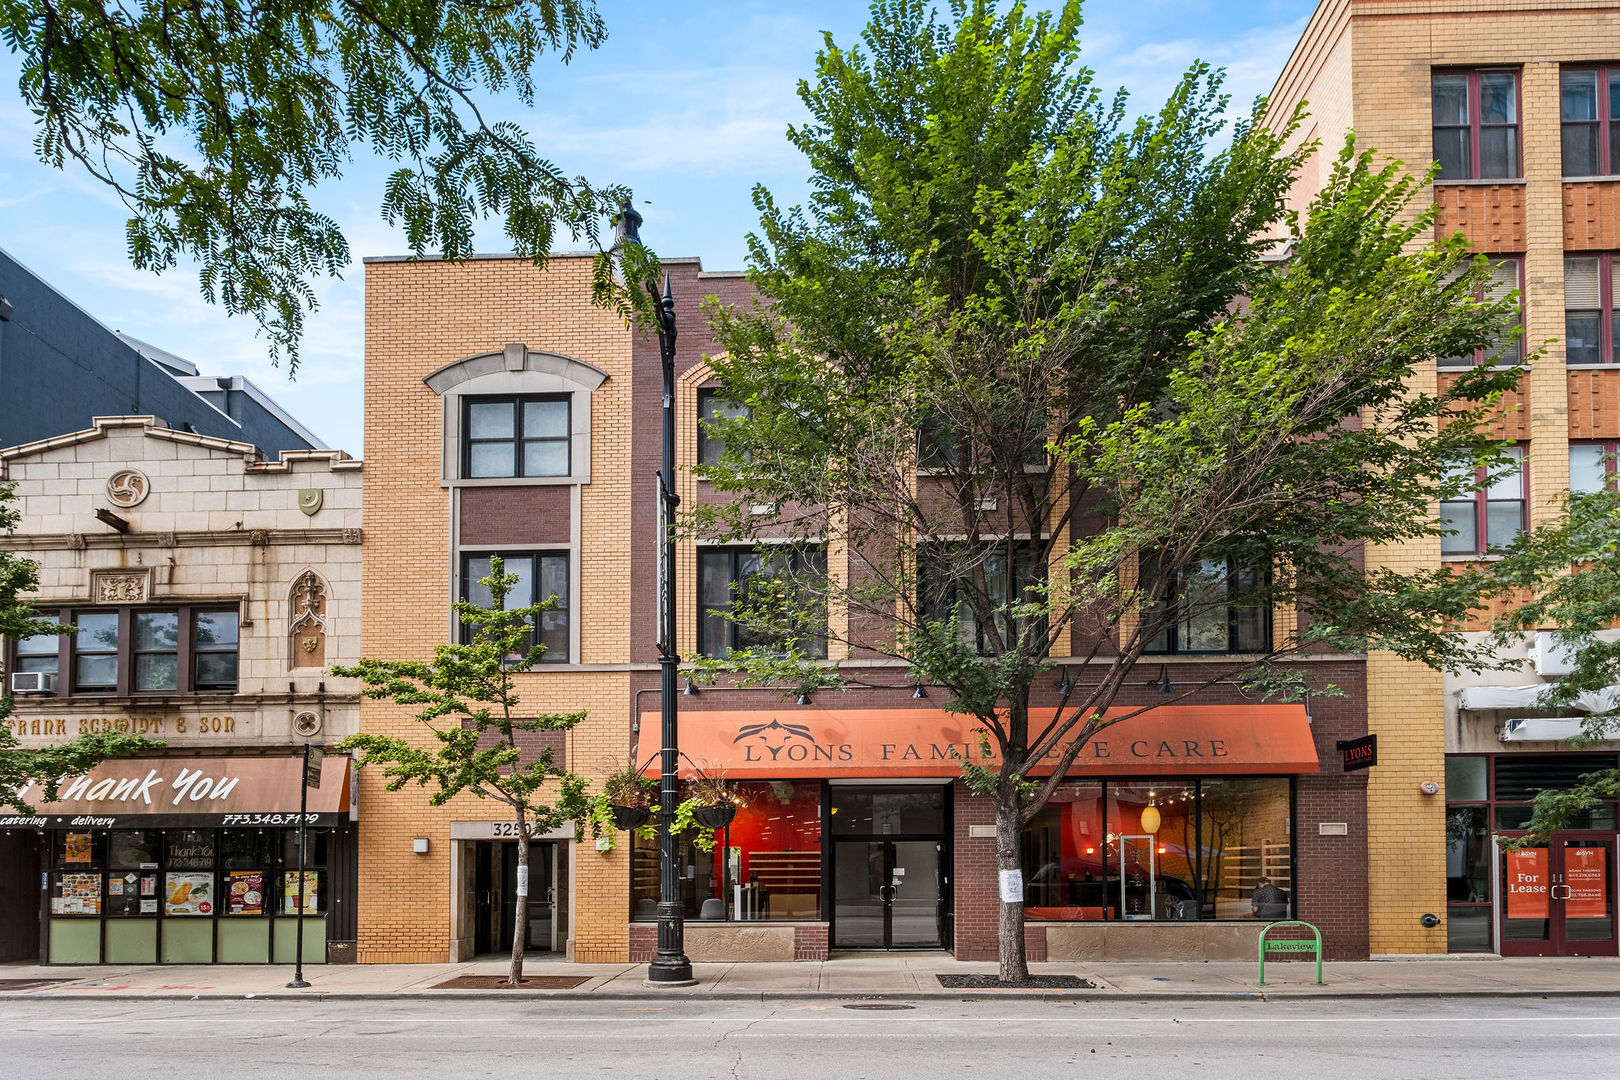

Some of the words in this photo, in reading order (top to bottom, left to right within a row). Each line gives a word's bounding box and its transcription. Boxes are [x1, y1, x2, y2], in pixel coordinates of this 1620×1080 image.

[176, 718, 187, 734] &
[200, 716, 236, 733] SON
[743, 744, 854, 762] LYONS
[880, 742, 998, 761] FAMIL
[1130, 740, 1228, 758] CARE
[1344, 744, 1374, 762] LYONS
[55, 768, 164, 805] hank
[171, 767, 240, 806] You
[0, 815, 48, 827] catering
[70, 815, 115, 828] delivery
[1517, 873, 1539, 882] For
[1510, 884, 1547, 893] Lease
[1266, 942, 1315, 951] Lakeview
